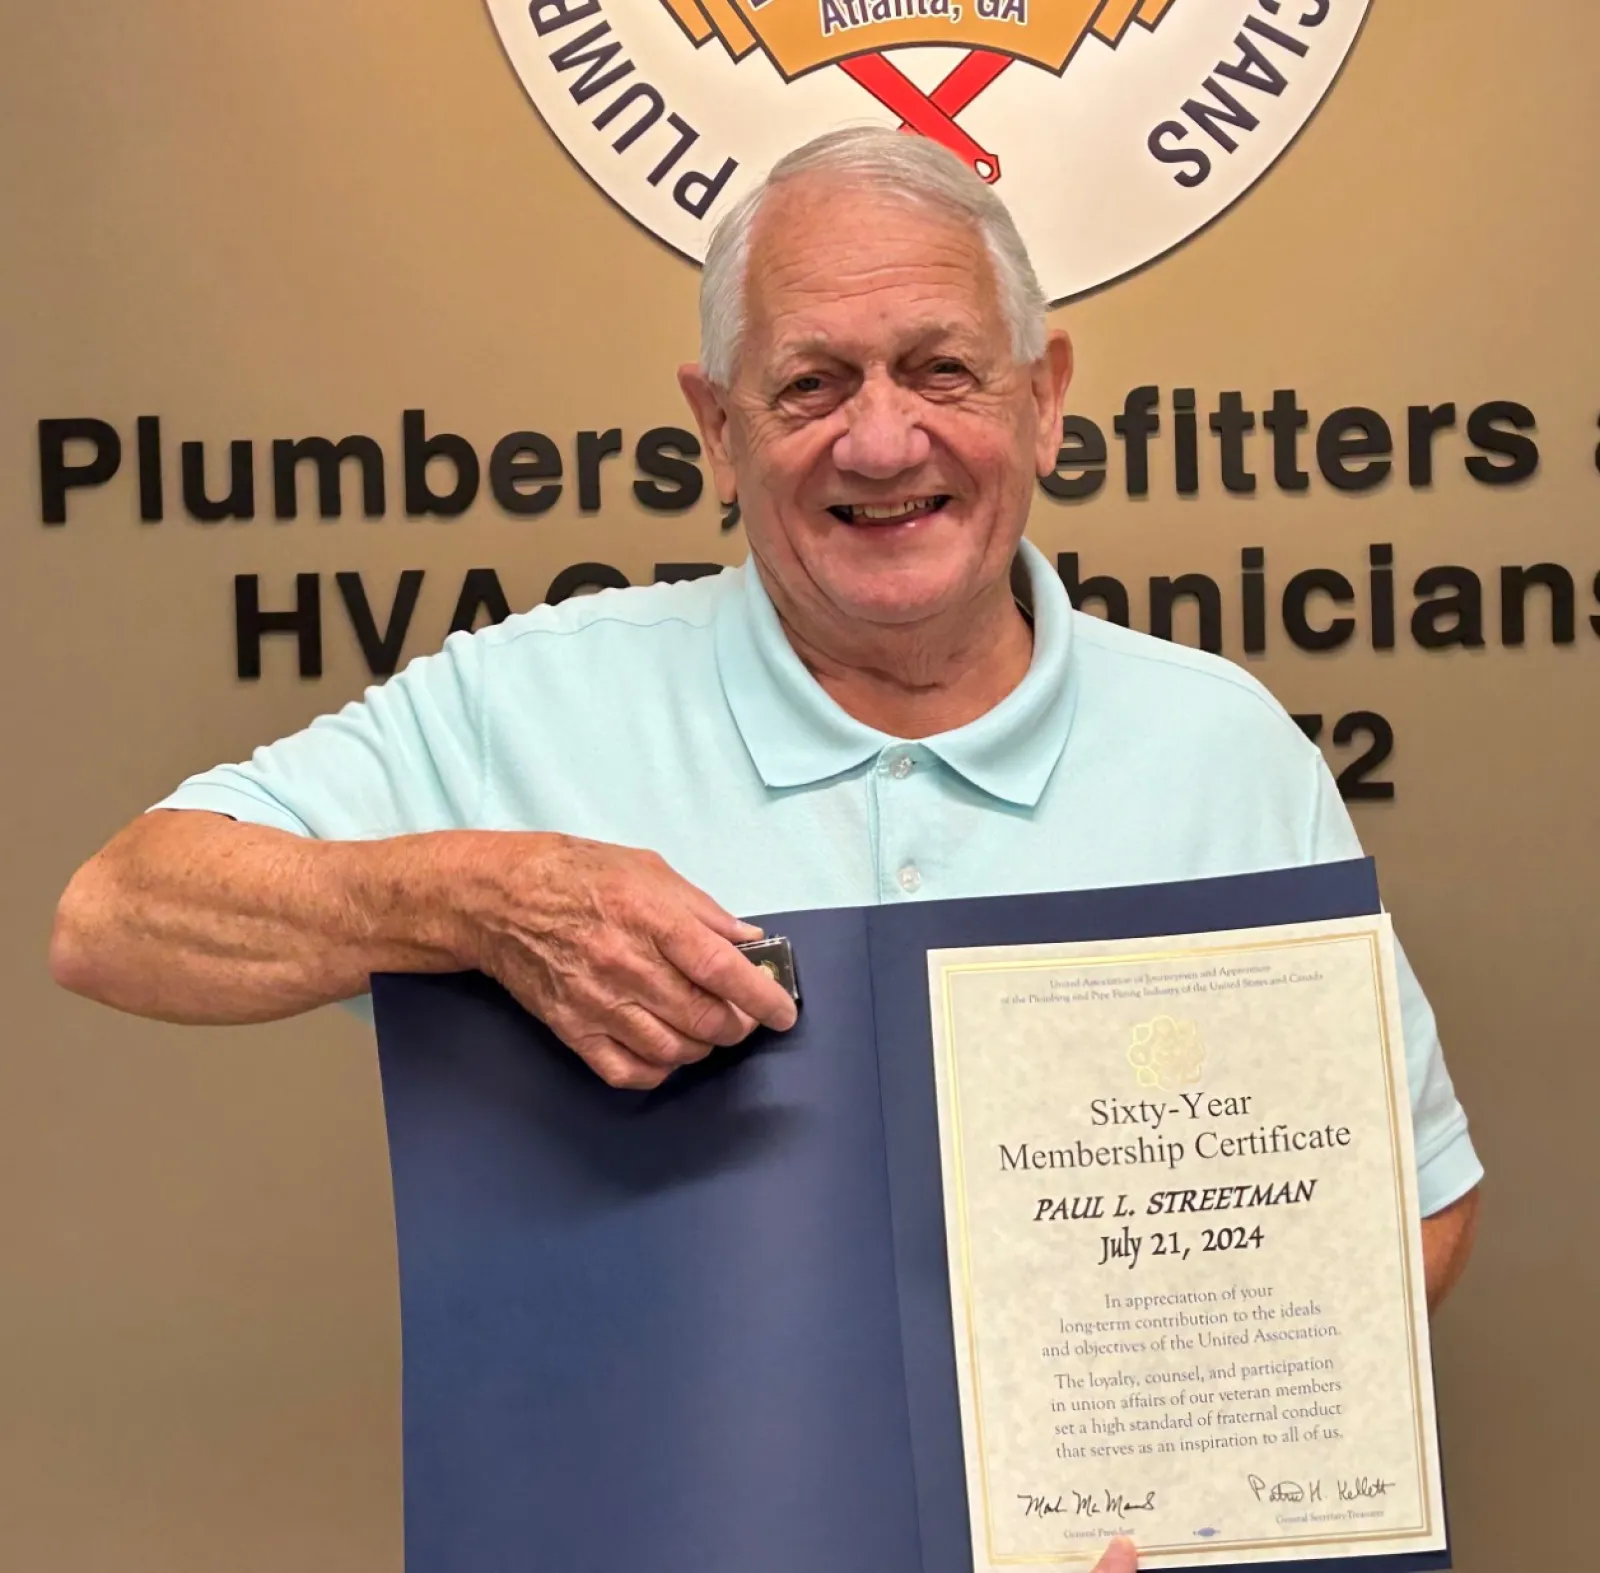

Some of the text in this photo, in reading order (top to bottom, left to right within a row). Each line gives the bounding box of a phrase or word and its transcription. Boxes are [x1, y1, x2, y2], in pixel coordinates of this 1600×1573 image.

[38, 409, 741, 528] Plumbers,
[233, 543, 1600, 680] HVA hnician
[1291, 711, 1395, 800] 2
[1090, 1092, 1252, 1129] Sixty-Year
[998, 1123, 1352, 1171] Membership Certificate
[1033, 1179, 1319, 1222] PAUL L. STREETMAN
[1098, 1225, 1265, 1269] July 21, 2024
[1105, 1284, 1274, 1310] In appreciation of your
[1060, 1300, 1322, 1336] long-term contribution to the ideals
[1041, 1323, 1342, 1358] and objectives of the United Association.
[1053, 1357, 1334, 1391] The loyalty, counsel, and participation
[1051, 1378, 1342, 1412] in union affairs of our veteran members
[1054, 1400, 1343, 1437] set a high standard of fraternal conduct
[1056, 1424, 1344, 1459] that serves as an inspiration to all of us.
